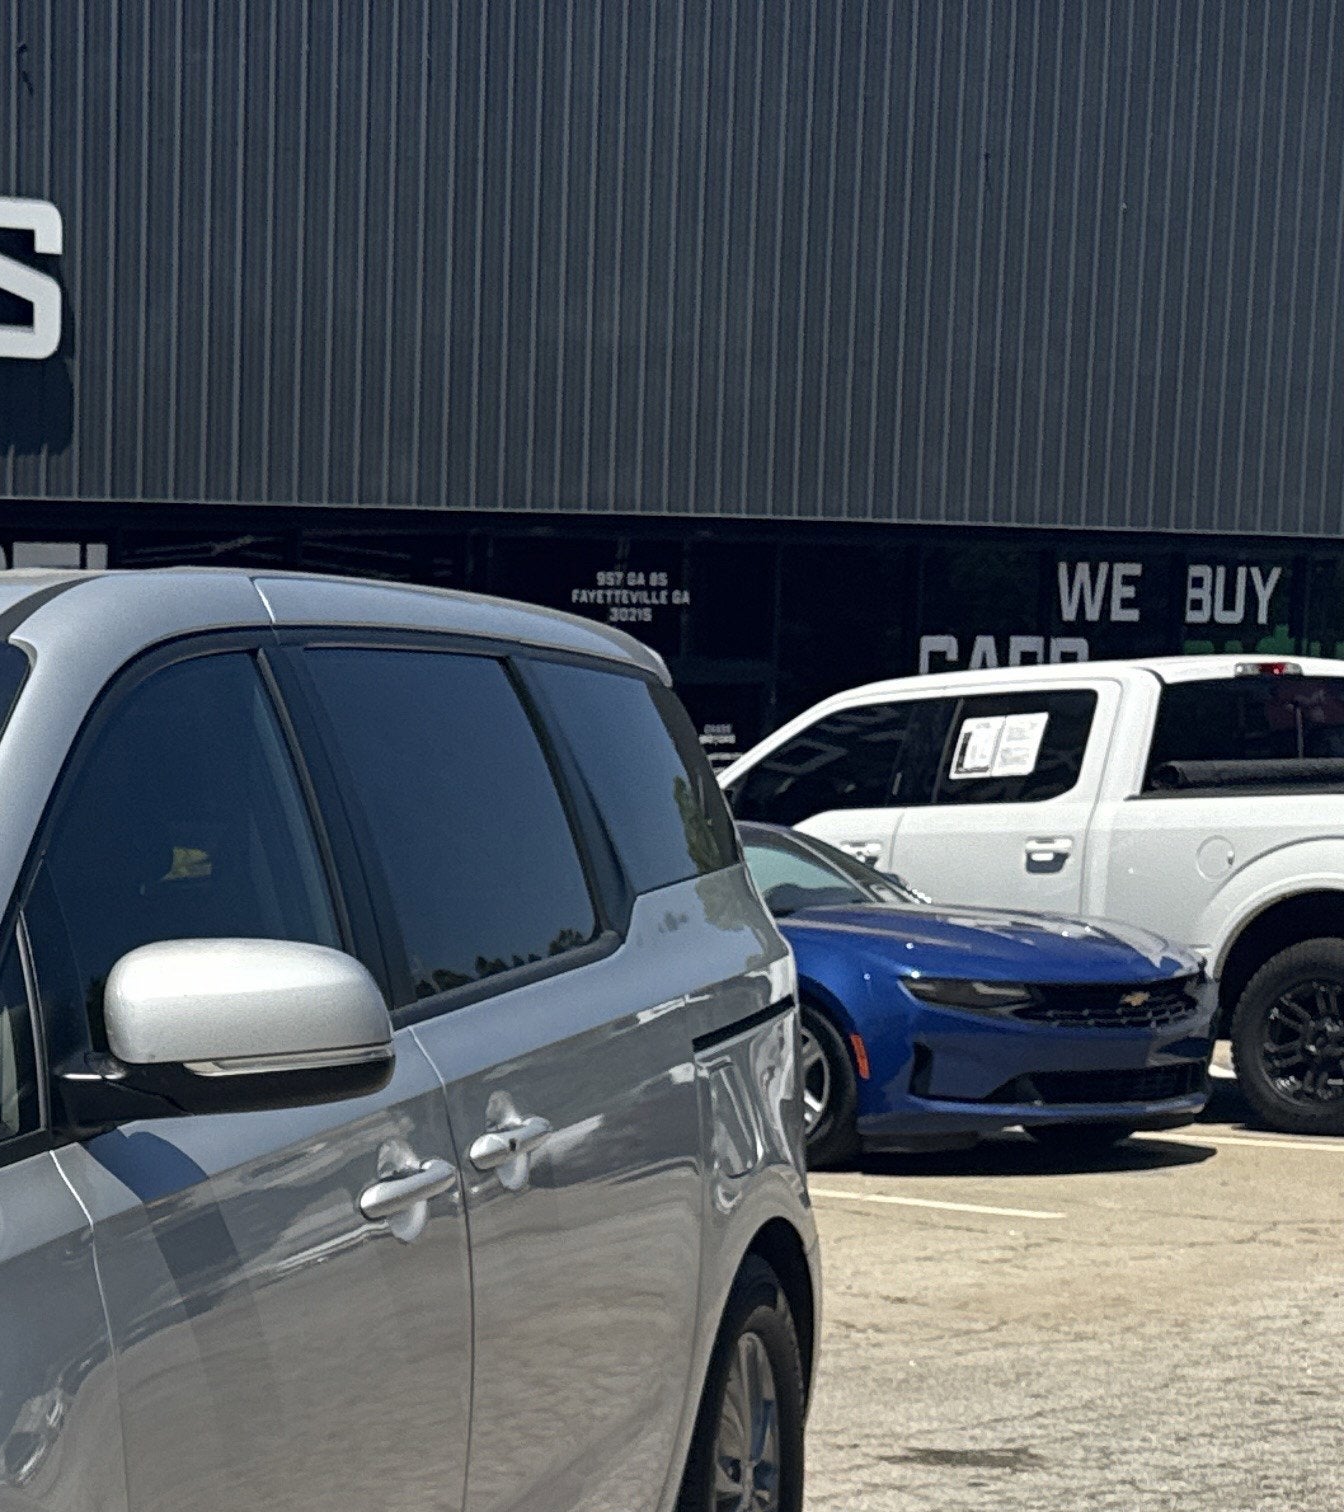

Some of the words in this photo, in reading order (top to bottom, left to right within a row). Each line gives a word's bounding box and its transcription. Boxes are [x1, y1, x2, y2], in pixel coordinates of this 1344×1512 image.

[571, 588, 669, 605] FAYETTEVILLE
[671, 589, 691, 605] GA
[1057, 561, 1143, 622] WE
[1184, 564, 1282, 625] BUY
